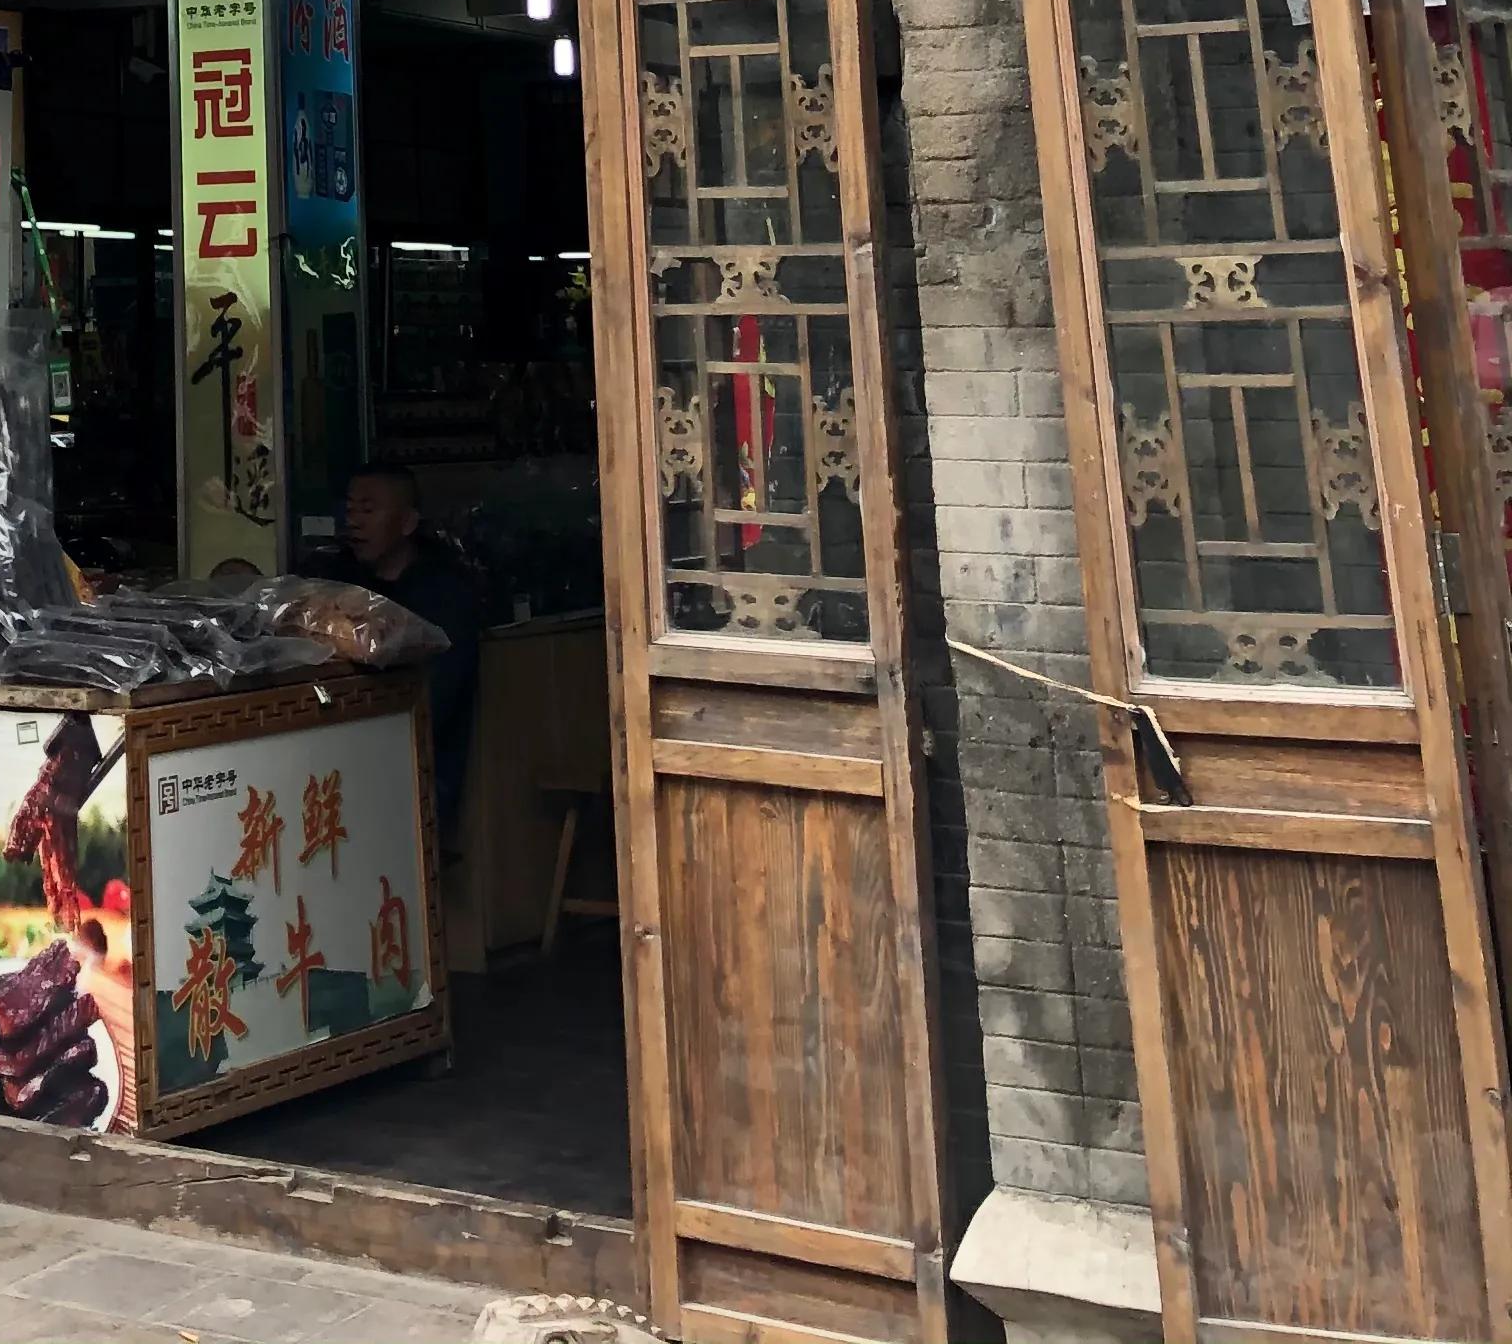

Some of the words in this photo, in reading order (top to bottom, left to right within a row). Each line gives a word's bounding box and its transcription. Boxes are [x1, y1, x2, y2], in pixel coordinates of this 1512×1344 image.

[186, 2, 256, 19] 中华老字号
[192, 48, 257, 259] 冠云
[182, 769, 237, 794] 中华老字号
[230, 769, 349, 894] 新鲜
[172, 875, 411, 1059] 散牛肉
